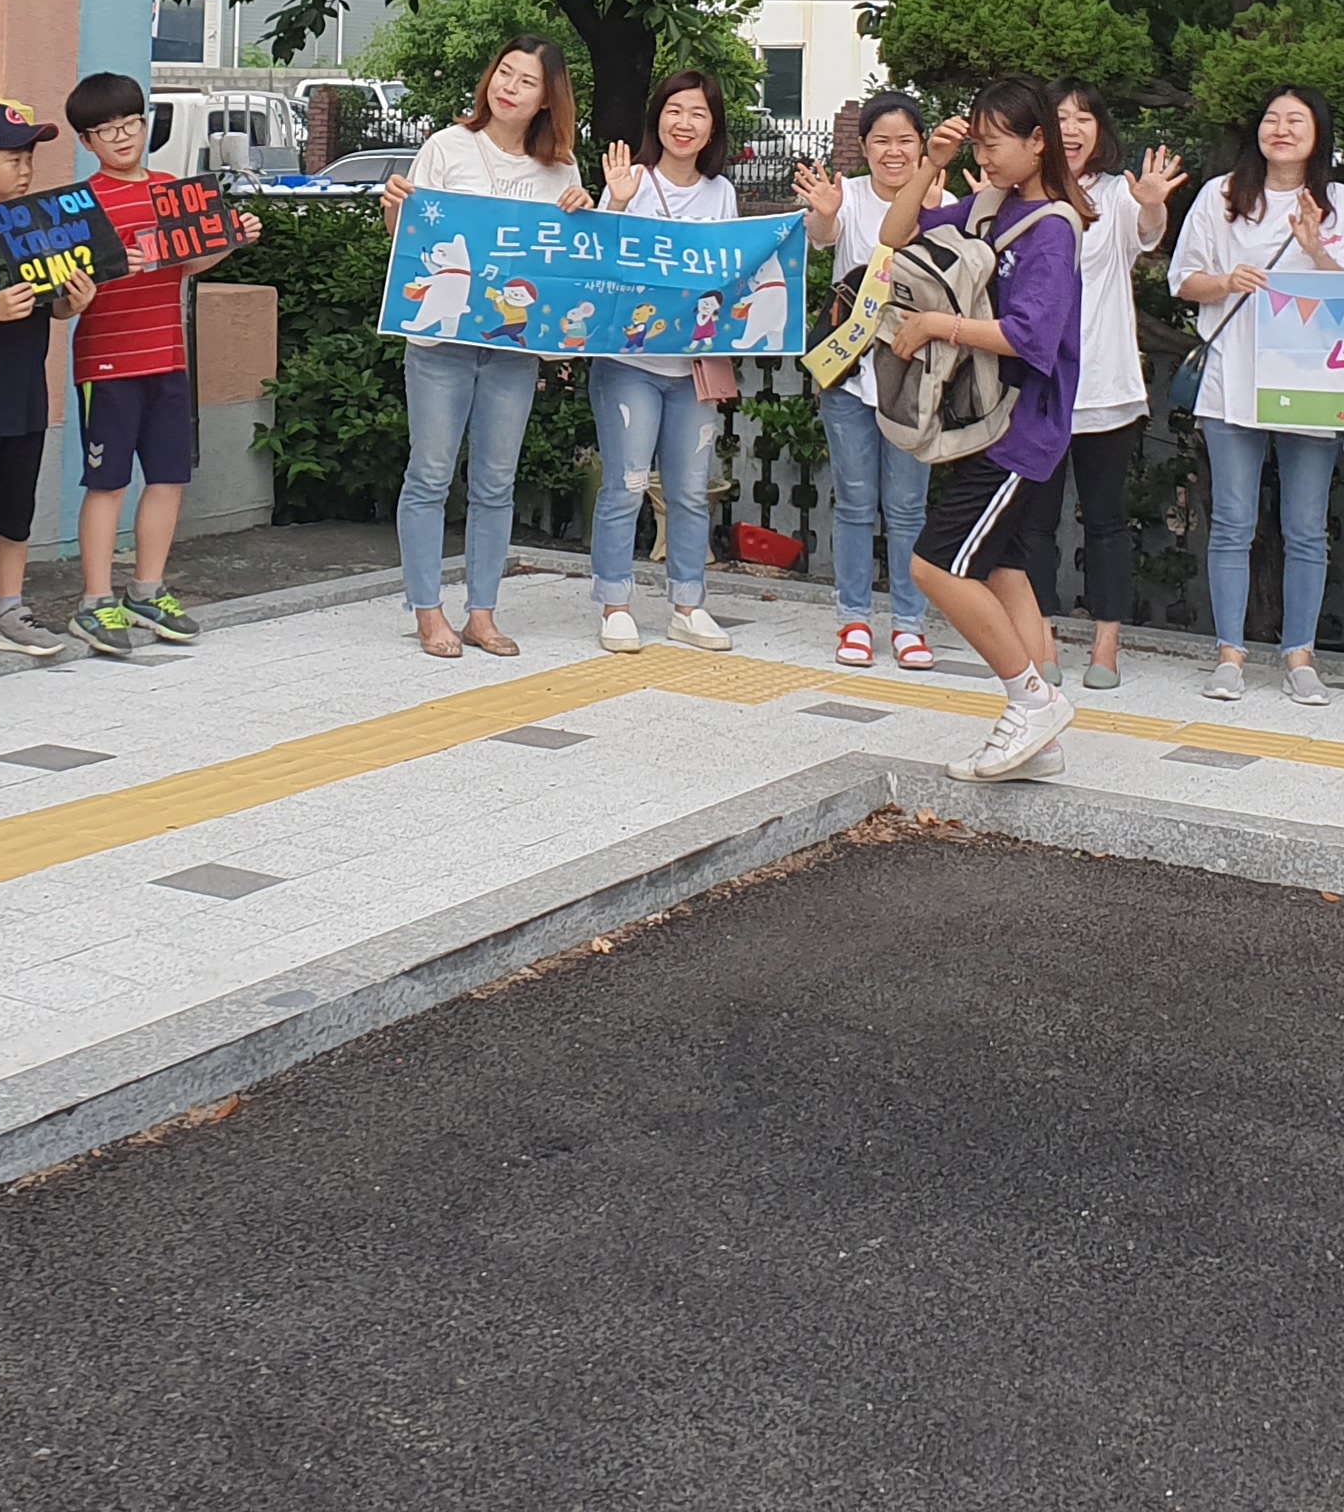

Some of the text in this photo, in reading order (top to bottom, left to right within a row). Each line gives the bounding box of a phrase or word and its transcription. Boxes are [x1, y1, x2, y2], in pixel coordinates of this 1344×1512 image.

[37, 189, 95, 225] you
[3, 219, 91, 260] know
[489, 221, 742, 278] 드루와 드루와!!
